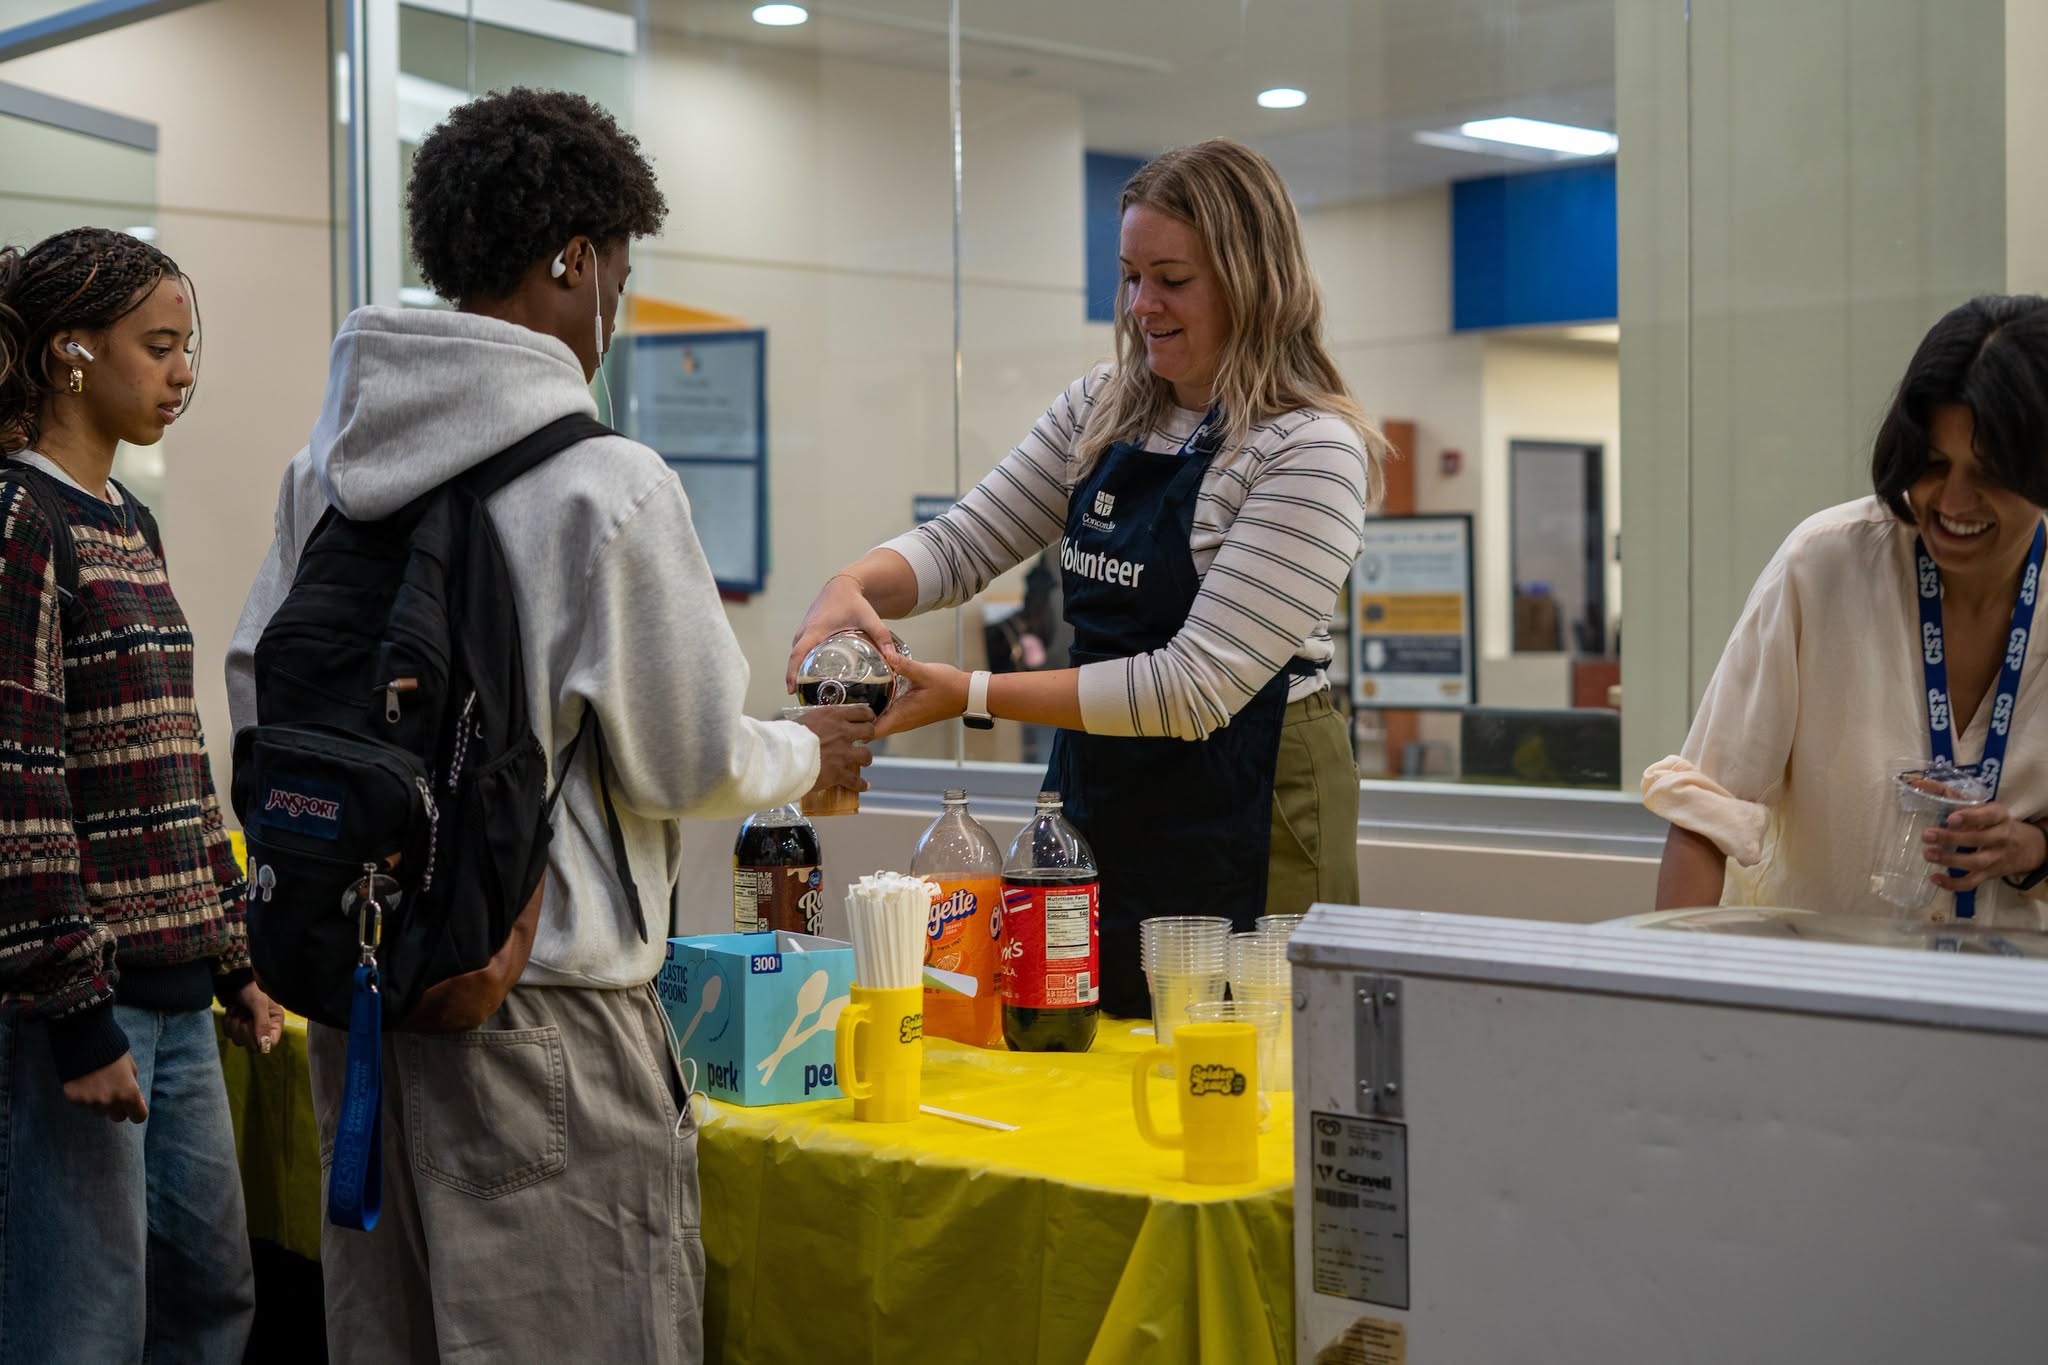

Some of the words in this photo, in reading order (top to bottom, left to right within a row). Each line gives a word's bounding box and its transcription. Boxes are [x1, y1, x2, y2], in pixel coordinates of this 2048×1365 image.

[1060, 535, 1144, 588] Volunteer
[1919, 555, 1939, 598] CSP
[2019, 562, 2039, 606] CSP
[1922, 621, 1943, 665] CSP
[2004, 627, 2027, 671] CSP
[1927, 687, 1949, 731] CSP
[1990, 692, 2014, 737] CSP
[265, 788, 340, 821] JANSPORT
[927, 889, 977, 939] gette
[753, 956, 776, 971] 300
[659, 981, 688, 1004] SPOONS
[707, 1061, 739, 1093] perk
[804, 1062, 838, 1096] pe
[1335, 1168, 1392, 1190] Caravell
